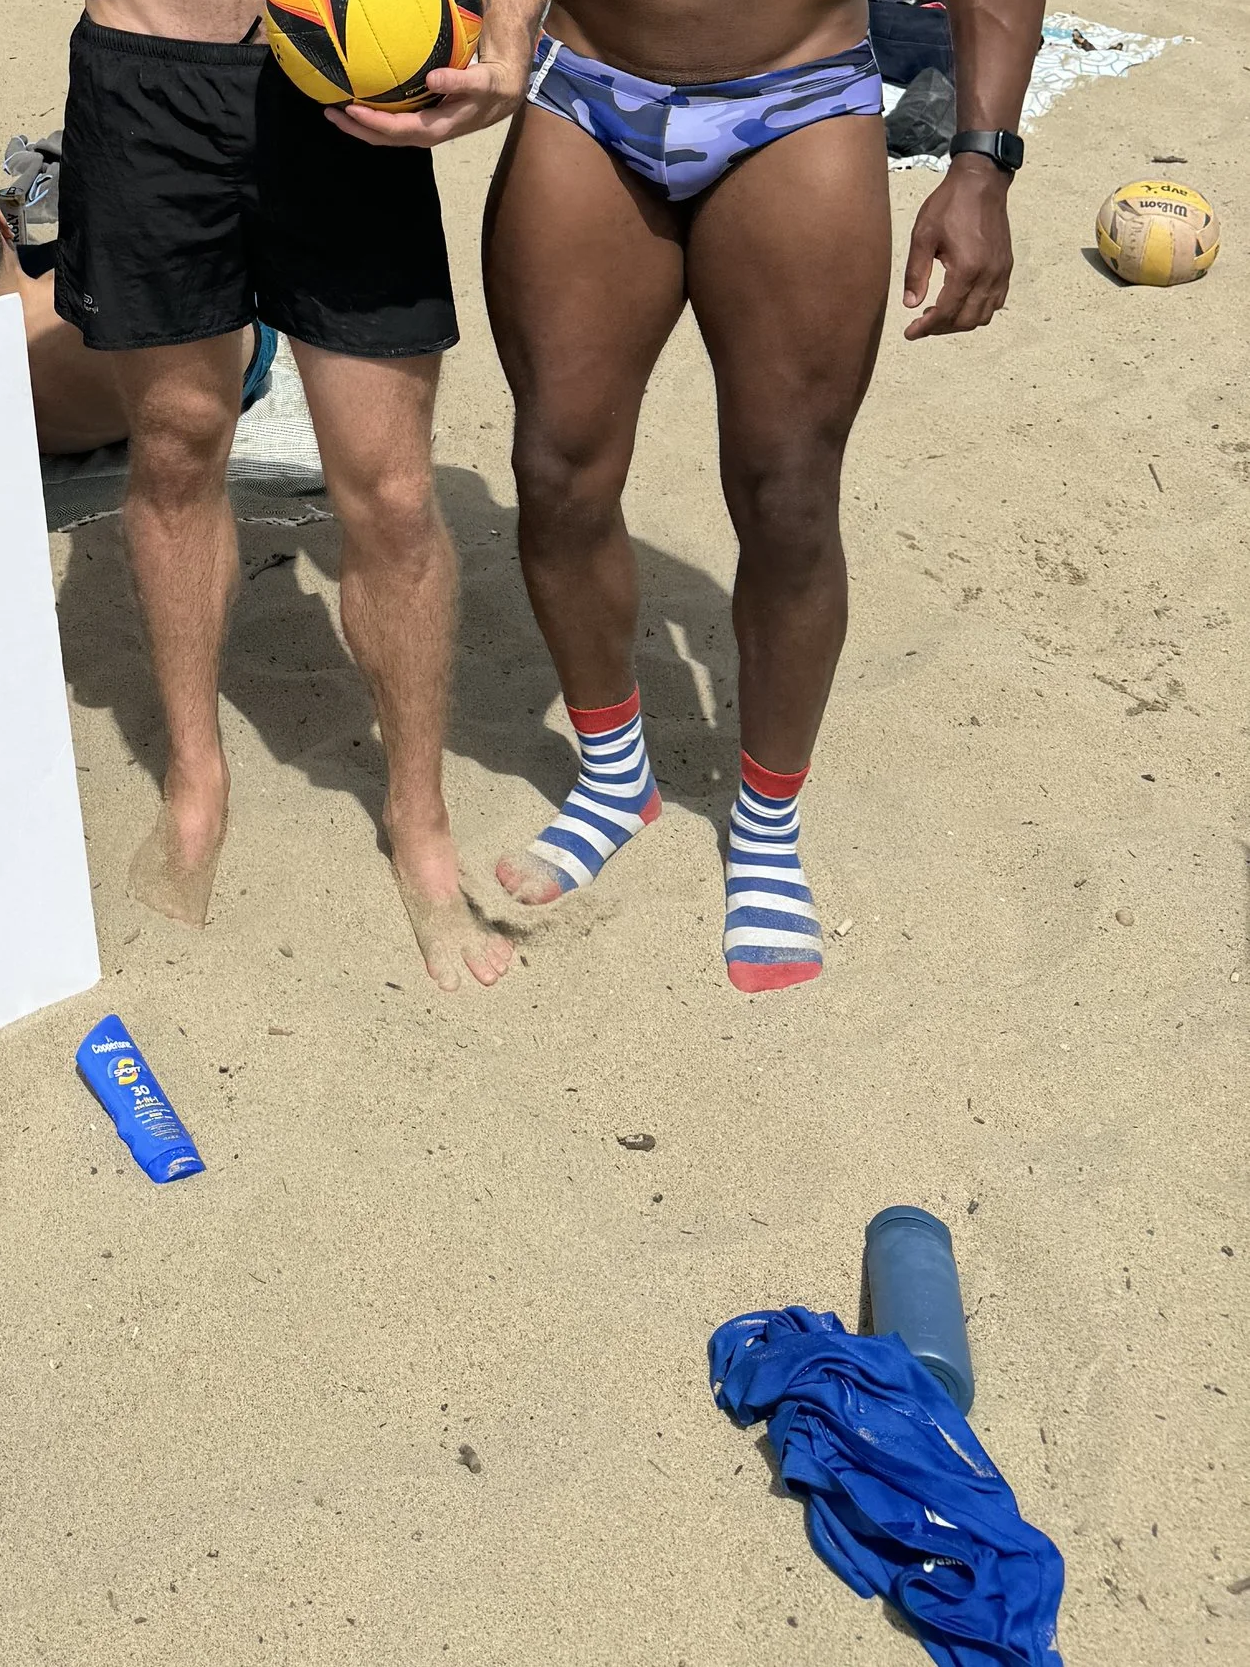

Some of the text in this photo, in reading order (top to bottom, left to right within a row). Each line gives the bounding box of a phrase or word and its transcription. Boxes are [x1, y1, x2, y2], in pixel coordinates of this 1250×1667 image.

[1160, 184, 1188, 197] avp
[1139, 200, 1188, 218] Wilson
[91, 1040, 133, 1054] Coppertone
[113, 1066, 141, 1078] SPORT
[130, 1085, 150, 1097] 30
